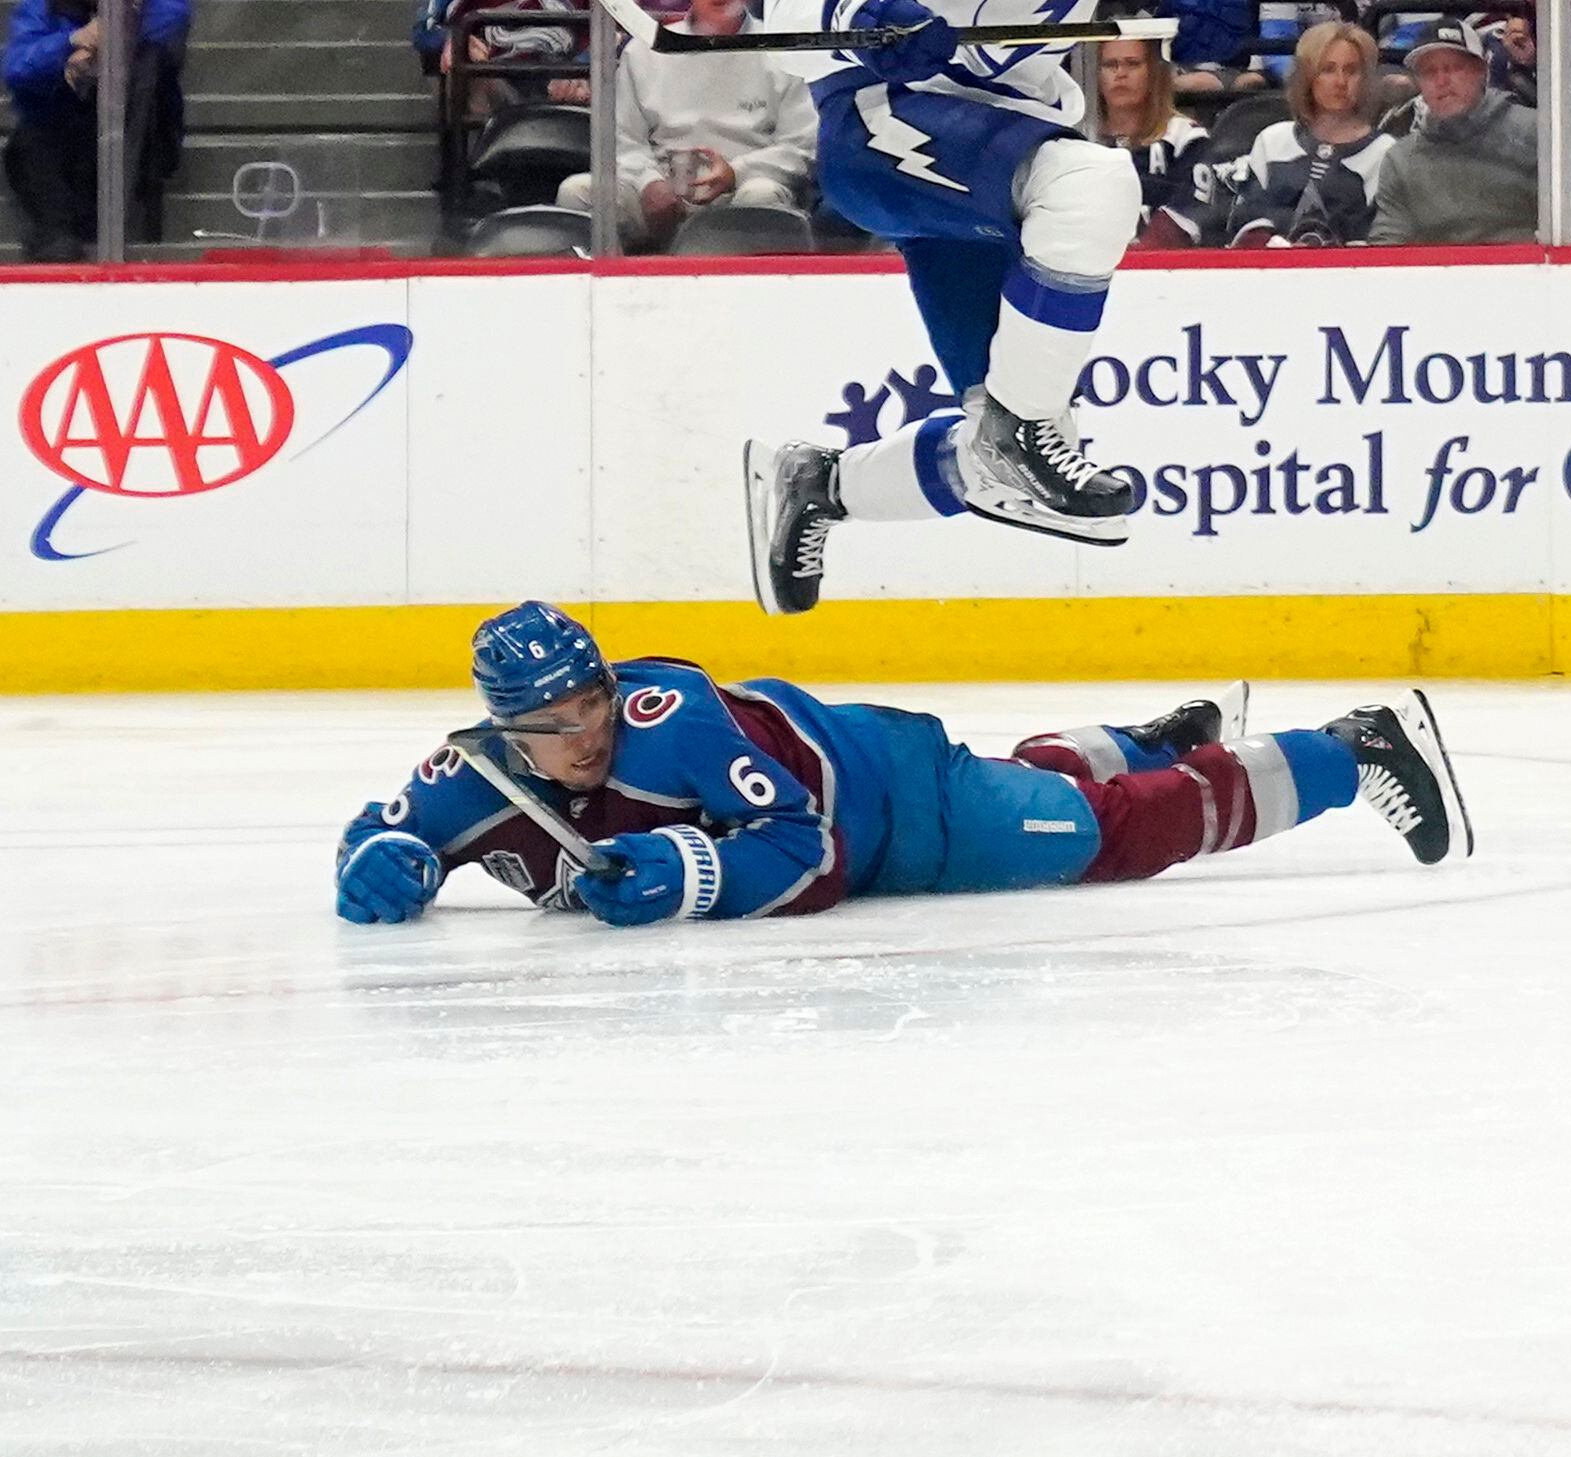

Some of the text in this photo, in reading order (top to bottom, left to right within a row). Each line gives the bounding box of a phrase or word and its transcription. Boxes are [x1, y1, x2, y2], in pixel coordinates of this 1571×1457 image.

[42, 334, 270, 494] AAA
[1067, 324, 1287, 424] ocky
[1078, 431, 1388, 537] ospital
[1411, 435, 1540, 534] for
[527, 640, 545, 659] 6
[728, 756, 776, 807] 6
